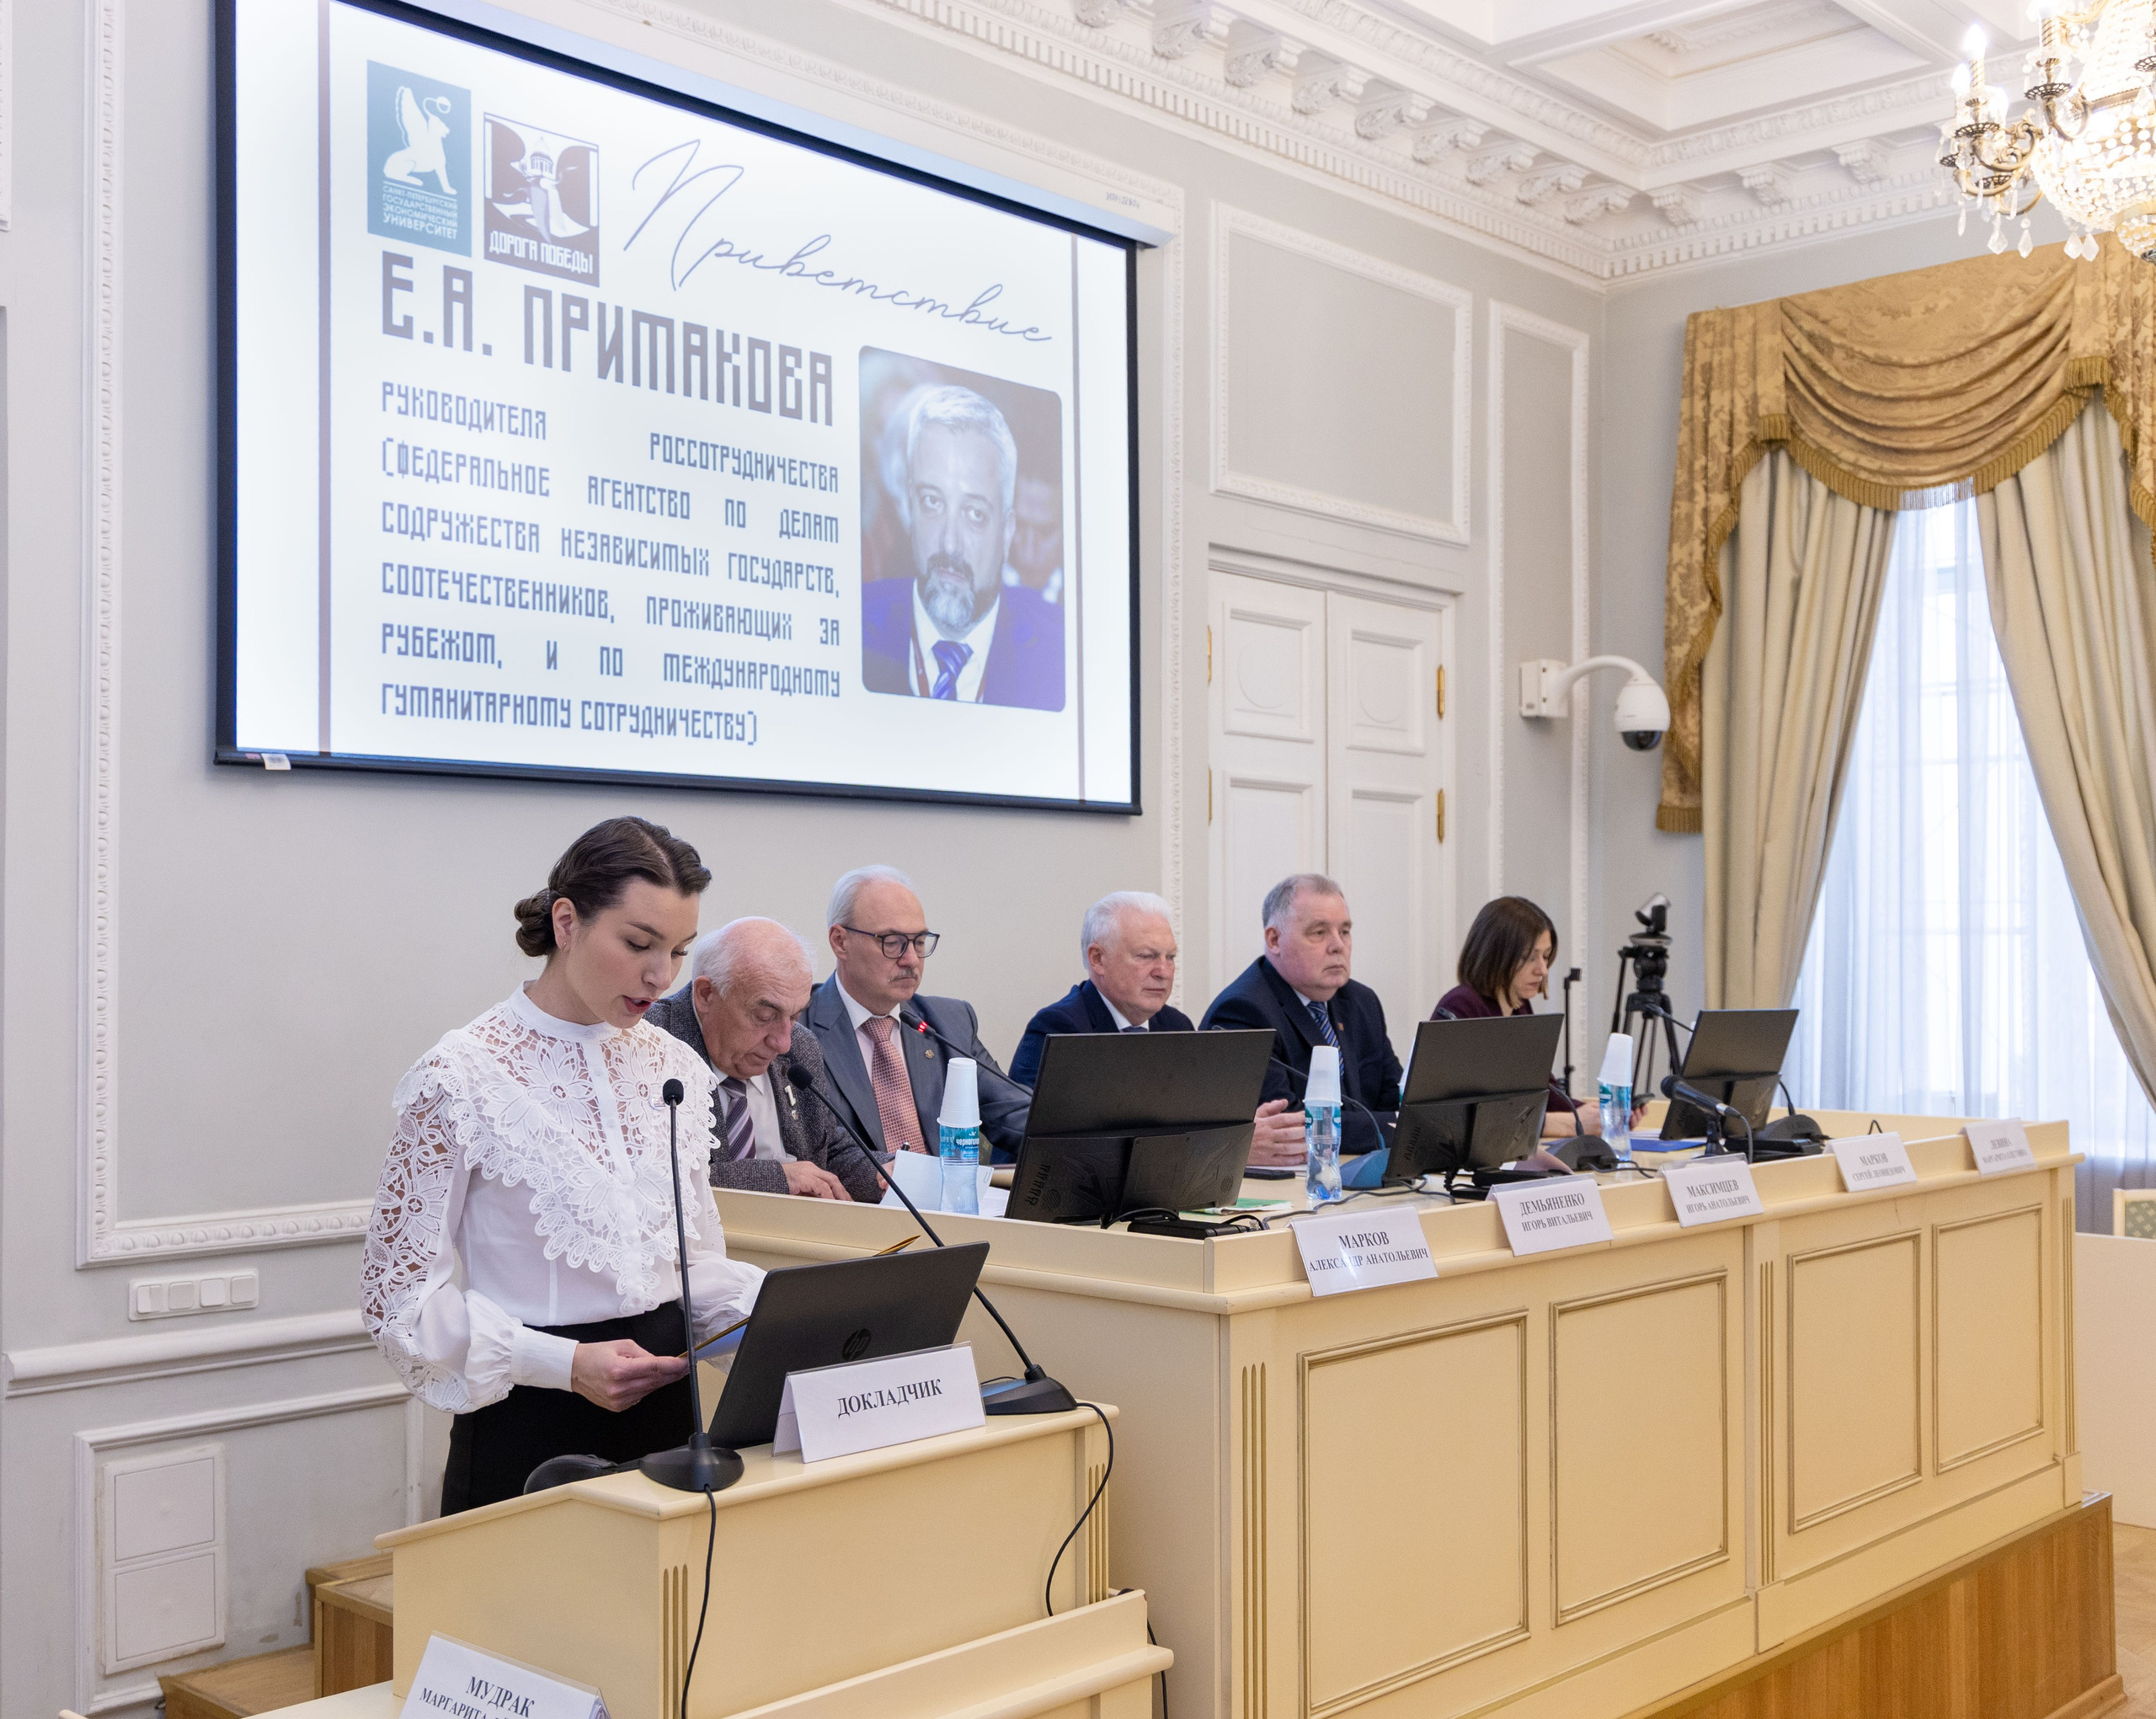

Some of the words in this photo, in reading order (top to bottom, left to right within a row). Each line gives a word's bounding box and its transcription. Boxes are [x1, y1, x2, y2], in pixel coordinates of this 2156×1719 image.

[382, 194, 457, 219] ГОСУДАРСТВЕННЫЙ
[382, 203, 457, 228] ЭКОНОМИЧЕСКИЙ
[382, 211, 457, 239] УНИВЕРСИТЕТ
[623, 139, 1052, 341] Приветствие
[489, 231, 537, 259] ДОРОГА
[541, 243, 593, 274] ПОБЕДЫ
[382, 250, 492, 356] Е.А.
[524, 285, 833, 427] ПРИМАКОВА
[382, 382, 547, 440] РУКОВОДИТЕЛЯ
[650, 432, 838, 494] РОССОТРУДНИЧЕСТВА
[382, 437, 549, 497] (ФЕДЕРАЛЬНОЕ
[588, 475, 691, 520] АГЕНТСТВО
[725, 498, 746, 529] ПО
[779, 509, 839, 543] ДЕЛАМ
[382, 501, 539, 553] СОДРУЖЕСТВА
[561, 527, 709, 577] НЕЗАВИСИМЫХ
[728, 552, 840, 598] ГОСУДАРСТВ,
[382, 562, 614, 623] СООТЕЧЕСТВЕННИКОВ,
[647, 595, 792, 642] ПРОЖИВАЮЩИХ
[819, 617, 840, 646] ЗА
[382, 622, 502, 669] РУБЕЖОМ,
[547, 640, 558, 670] И
[600, 646, 623, 676] ПО
[663, 653, 841, 697] МЕЖДУНАРОДНОМУ
[382, 683, 571, 729] ГУМАНИТАРНОМУ
[581, 701, 757, 745] СОТРУДНИЧЕСТВУ)
[1853, 1170, 1873, 1182] СЕРГЕЙ
[1859, 1153, 1889, 1166] МАРКОВ
[1519, 1193, 1585, 1216] ДЕМЬЯНЕНКО
[1686, 1179, 1739, 1198] МАКСИМЦЕВ
[1686, 1202, 1708, 1214] ИГОРЬ
[1707, 1195, 1751, 1210] АНАТОЛЬЕВИЧ
[1521, 1219, 1547, 1231] ИГОРЬ
[1546, 1210, 1593, 1228] ВИТАЛЬЕВИЧ
[1338, 1231, 1390, 1250] МАРКОВ
[1366, 1247, 1429, 1265] АНАТОЛЬЕВИЧ
[837, 1378, 943, 1419] ДОКЛАДЧИК
[466, 1676, 535, 1718] МУДРАК
